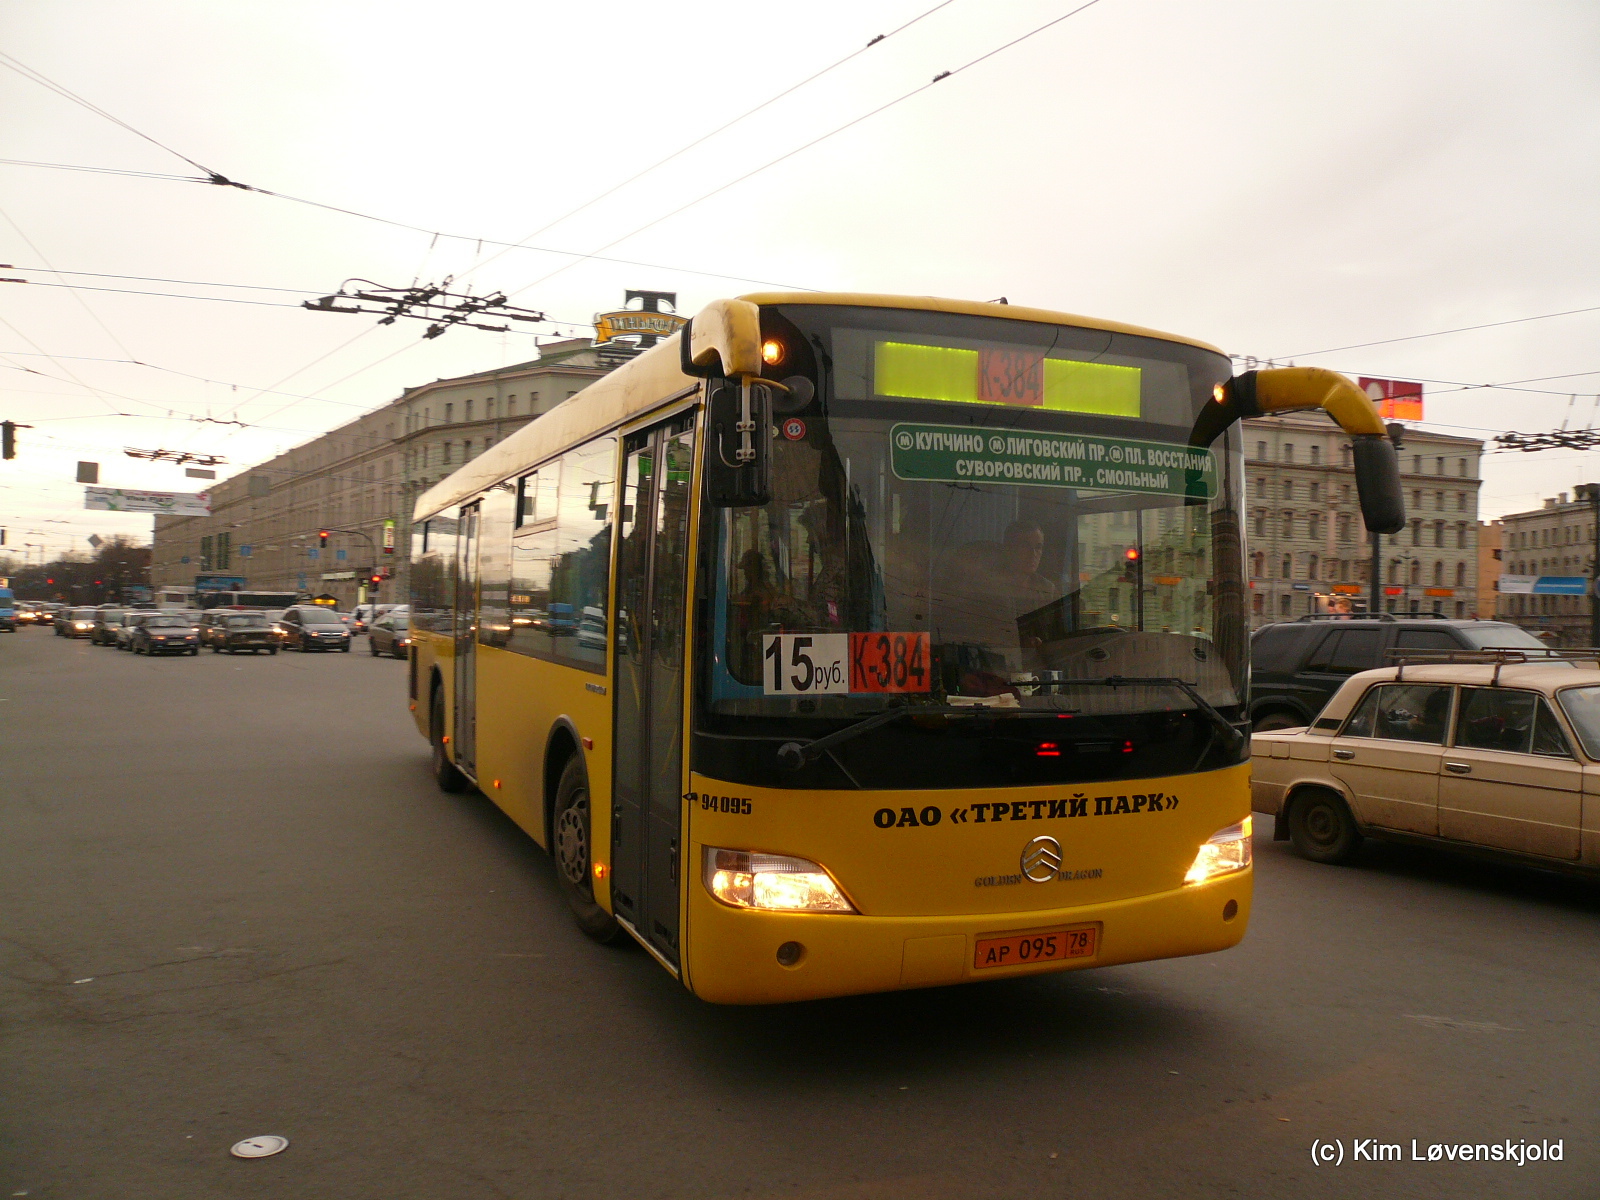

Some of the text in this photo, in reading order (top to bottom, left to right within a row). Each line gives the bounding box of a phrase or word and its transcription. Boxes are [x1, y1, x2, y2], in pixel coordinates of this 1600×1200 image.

[980, 348, 1041, 401] К-384
[916, 431, 984, 454] КУПЧИНО
[1007, 437, 1086, 460] ЛИГОВСКИЙ
[1088, 443, 1109, 462] ПР.
[1125, 447, 1145, 466] ПЛ.
[1147, 449, 1213, 473] ВОССТАНИЯ
[956, 459, 1061, 481] СУВОРОВСКИЙ
[1097, 468, 1170, 489] СМОЛЬНЫЙ
[852, 633, 925, 690] К-384
[873, 793, 1180, 829] ОАО «ТРЕТИЙ ПАРК»
[974, 868, 1103, 888] GOLDEN DRAGON
[1019, 936, 1057, 960] 095
[1069, 932, 1088, 949] 78
